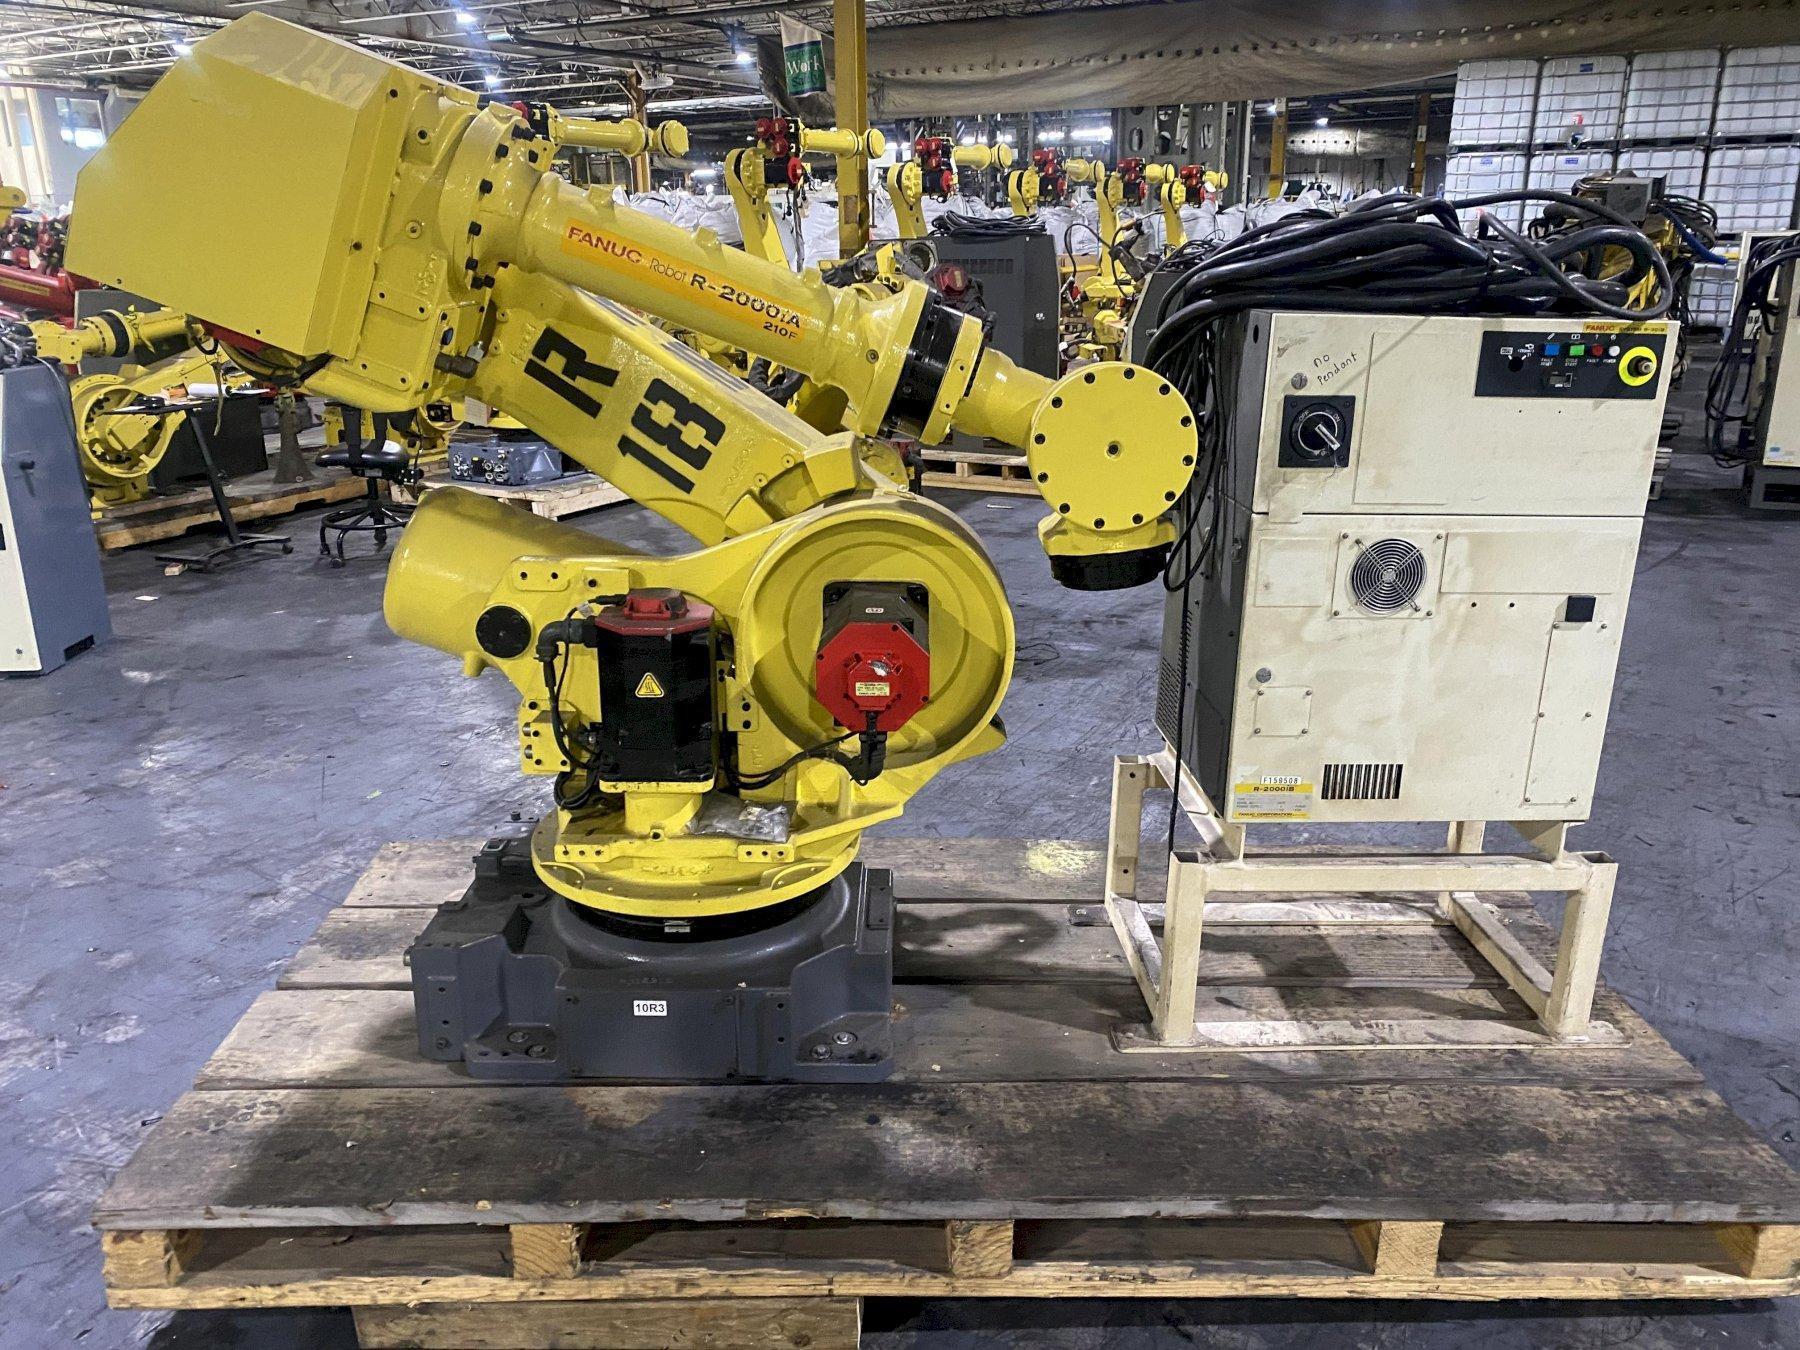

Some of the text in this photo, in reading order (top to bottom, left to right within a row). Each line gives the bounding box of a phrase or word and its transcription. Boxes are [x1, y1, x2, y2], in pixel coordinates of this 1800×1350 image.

[787, 55, 822, 74] Work
[567, 226, 643, 264] FANUC
[649, 258, 688, 283] Robot
[762, 321, 799, 341] 210F
[1585, 324, 1615, 332] FANUC
[523, 326, 620, 419] R
[1299, 410, 1310, 421] OFF
[1333, 413, 1341, 422] ON
[617, 378, 727, 495] 18
[635, 1003, 665, 1012] 10R3
